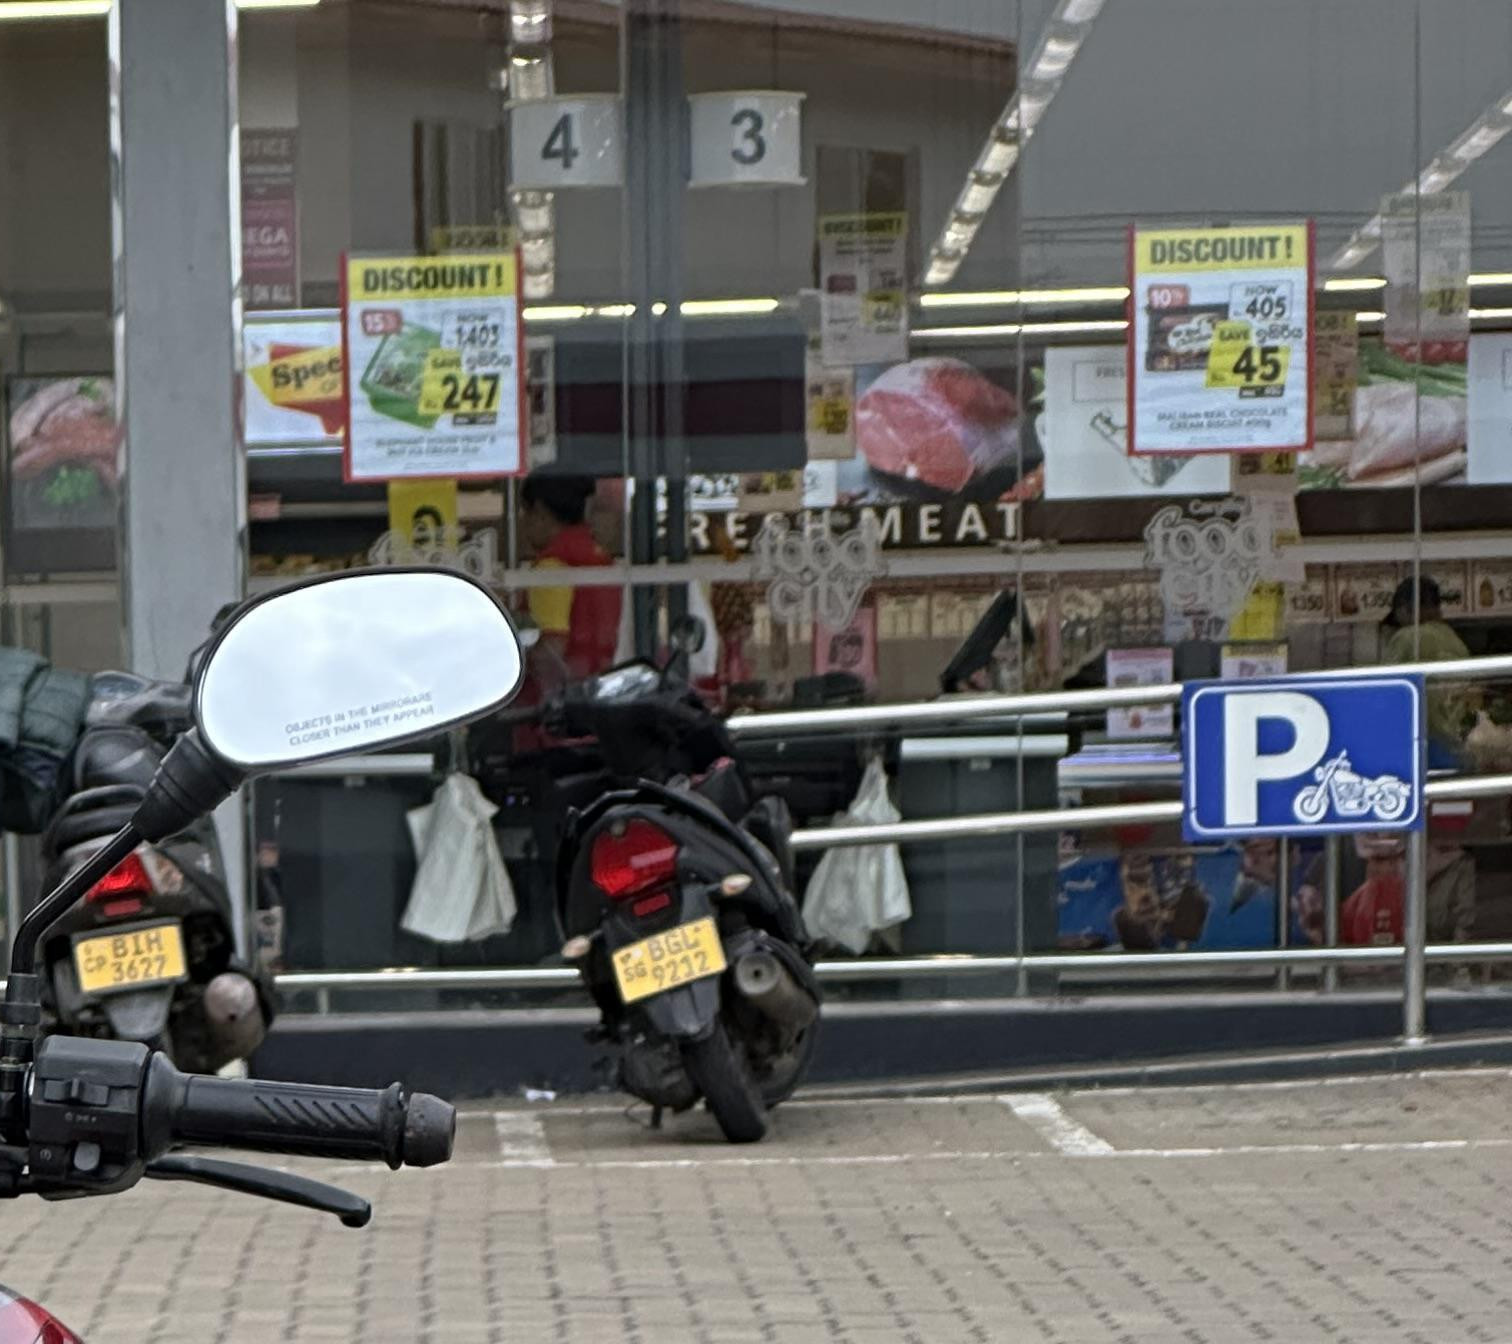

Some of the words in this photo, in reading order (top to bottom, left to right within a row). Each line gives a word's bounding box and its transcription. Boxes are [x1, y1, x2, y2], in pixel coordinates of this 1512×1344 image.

[541, 113, 579, 169] 4
[731, 108, 766, 165] 3
[1245, 296, 1287, 318] 405
[1232, 346, 1282, 382] 45
[442, 373, 500, 411] 247
[285, 714, 332, 735] OBJECTS
[334, 712, 346, 722] IN
[348, 706, 368, 719] THE
[289, 728, 331, 747] CLOSER
[334, 722, 361, 737] THAN
[364, 715, 390, 730] THEY
[393, 704, 434, 722] APPEAR
[1224, 691, 1331, 826] P
[110, 954, 167, 983] 3627
